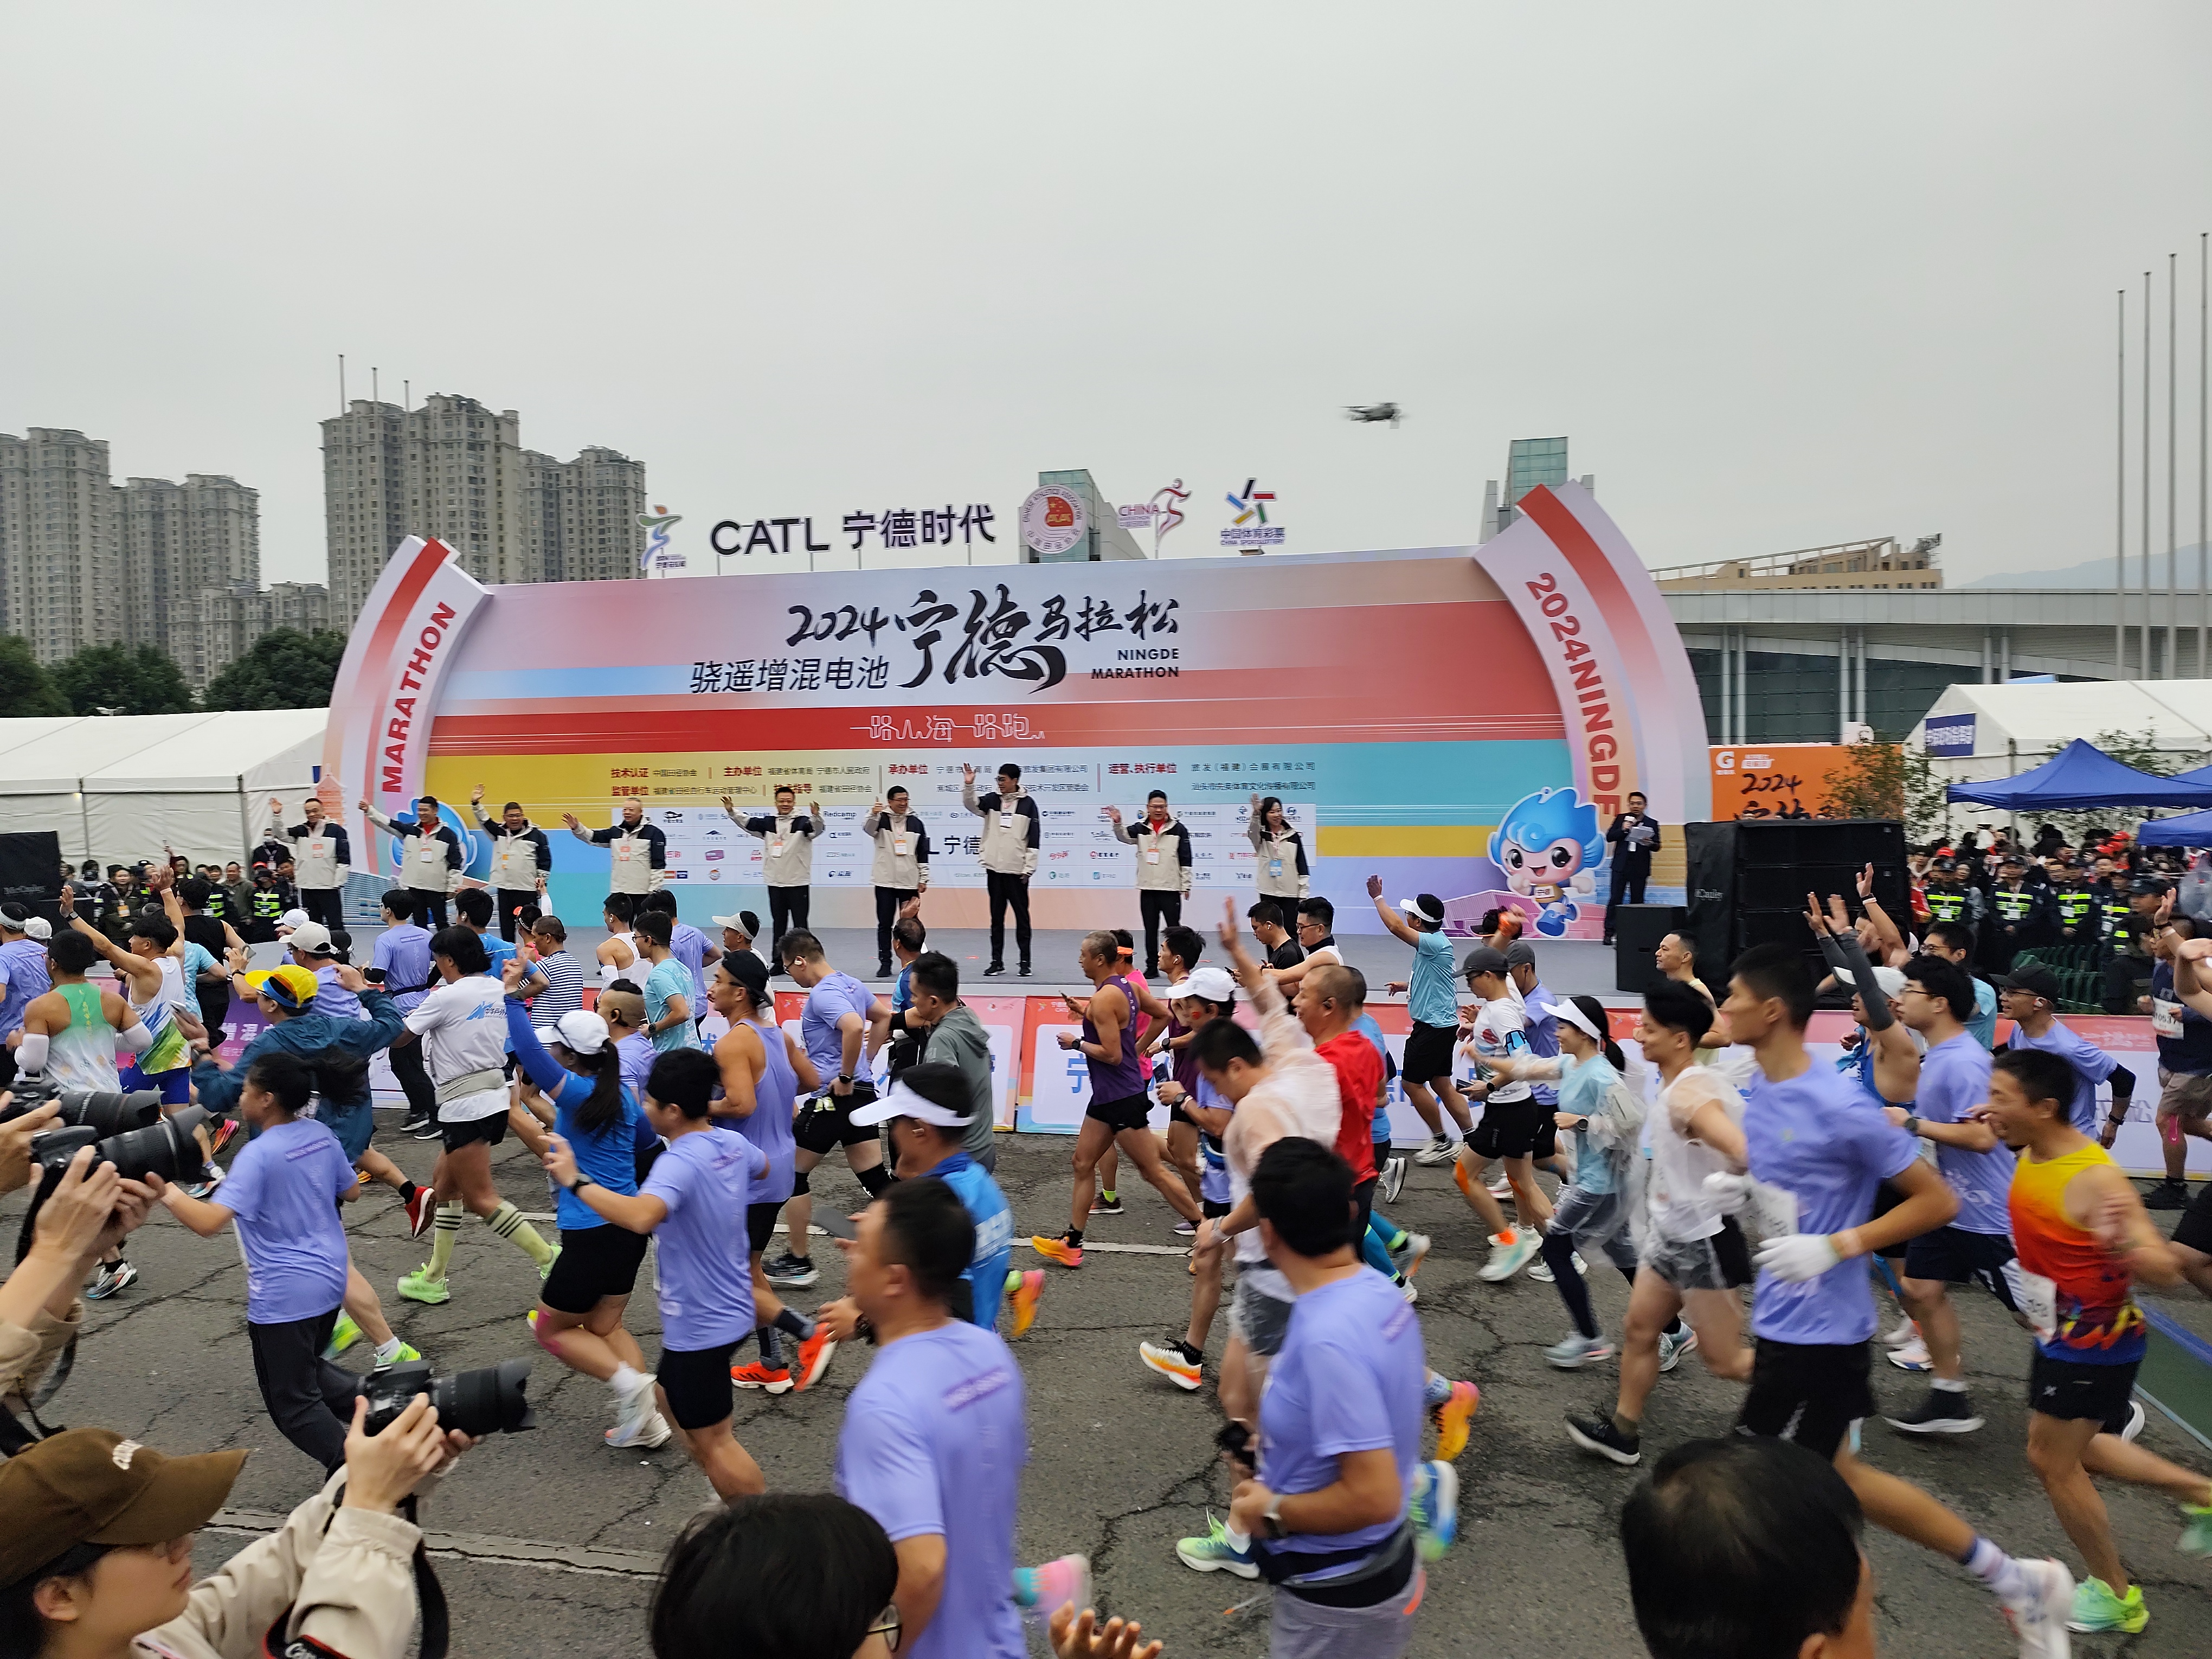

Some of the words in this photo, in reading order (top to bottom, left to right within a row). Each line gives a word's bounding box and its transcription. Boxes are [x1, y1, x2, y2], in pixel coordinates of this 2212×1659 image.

[1118, 504, 1162, 516] CHINA
[842, 502, 997, 550] 宁德时代
[710, 517, 831, 557] CATL
[1117, 647, 1180, 661] NINGDE
[689, 654, 890, 695] 骁遥增混电池
[1091, 665, 1180, 680] MARATHON
[382, 601, 458, 793] MARATHON
[610, 767, 650, 779] 技术认证
[724, 766, 763, 777] 主办单位
[888, 764, 929, 775] 承办单位
[1741, 773, 1803, 795] 2024
